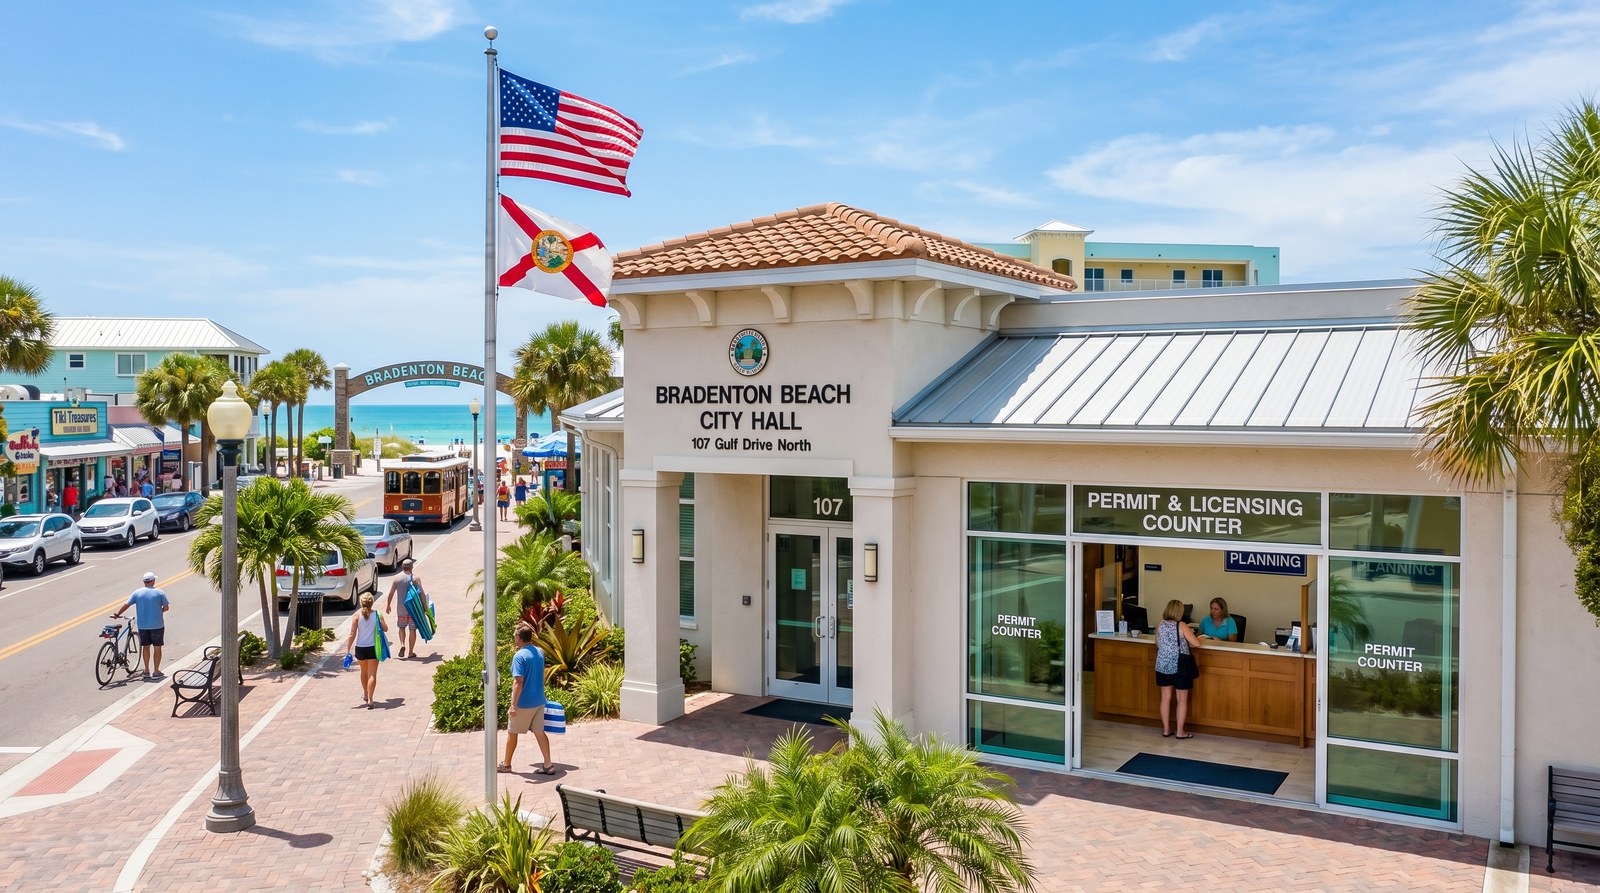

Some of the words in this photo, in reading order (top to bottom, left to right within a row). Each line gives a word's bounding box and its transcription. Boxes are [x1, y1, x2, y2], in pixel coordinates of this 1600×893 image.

[365, 364, 445, 385] BRADENTON
[452, 365, 485, 382] BEAC
[656, 385, 772, 404] BRADENTON
[780, 384, 851, 404] BEACH
[68, 411, 97, 423] Treasures
[700, 411, 743, 430] CITY
[751, 411, 802, 430] HALL
[691, 437, 711, 449] 107
[714, 437, 738, 450] Gulf
[743, 438, 773, 451] Drive
[777, 438, 811, 452] North
[813, 497, 843, 515] 107
[1088, 492, 1160, 510] PERMIT
[1167, 495, 1183, 512] &
[1189, 496, 1303, 516] LICENSING
[1142, 514, 1242, 535] COUNTER
[1230, 552, 1301, 568] PLANNING
[1357, 561, 1436, 576] PLANNING
[997, 614, 1036, 627] PERMIT
[991, 626, 1042, 638] COUNTER
[1365, 643, 1415, 657] PERMIT
[1357, 656, 1422, 672] COUNTER
